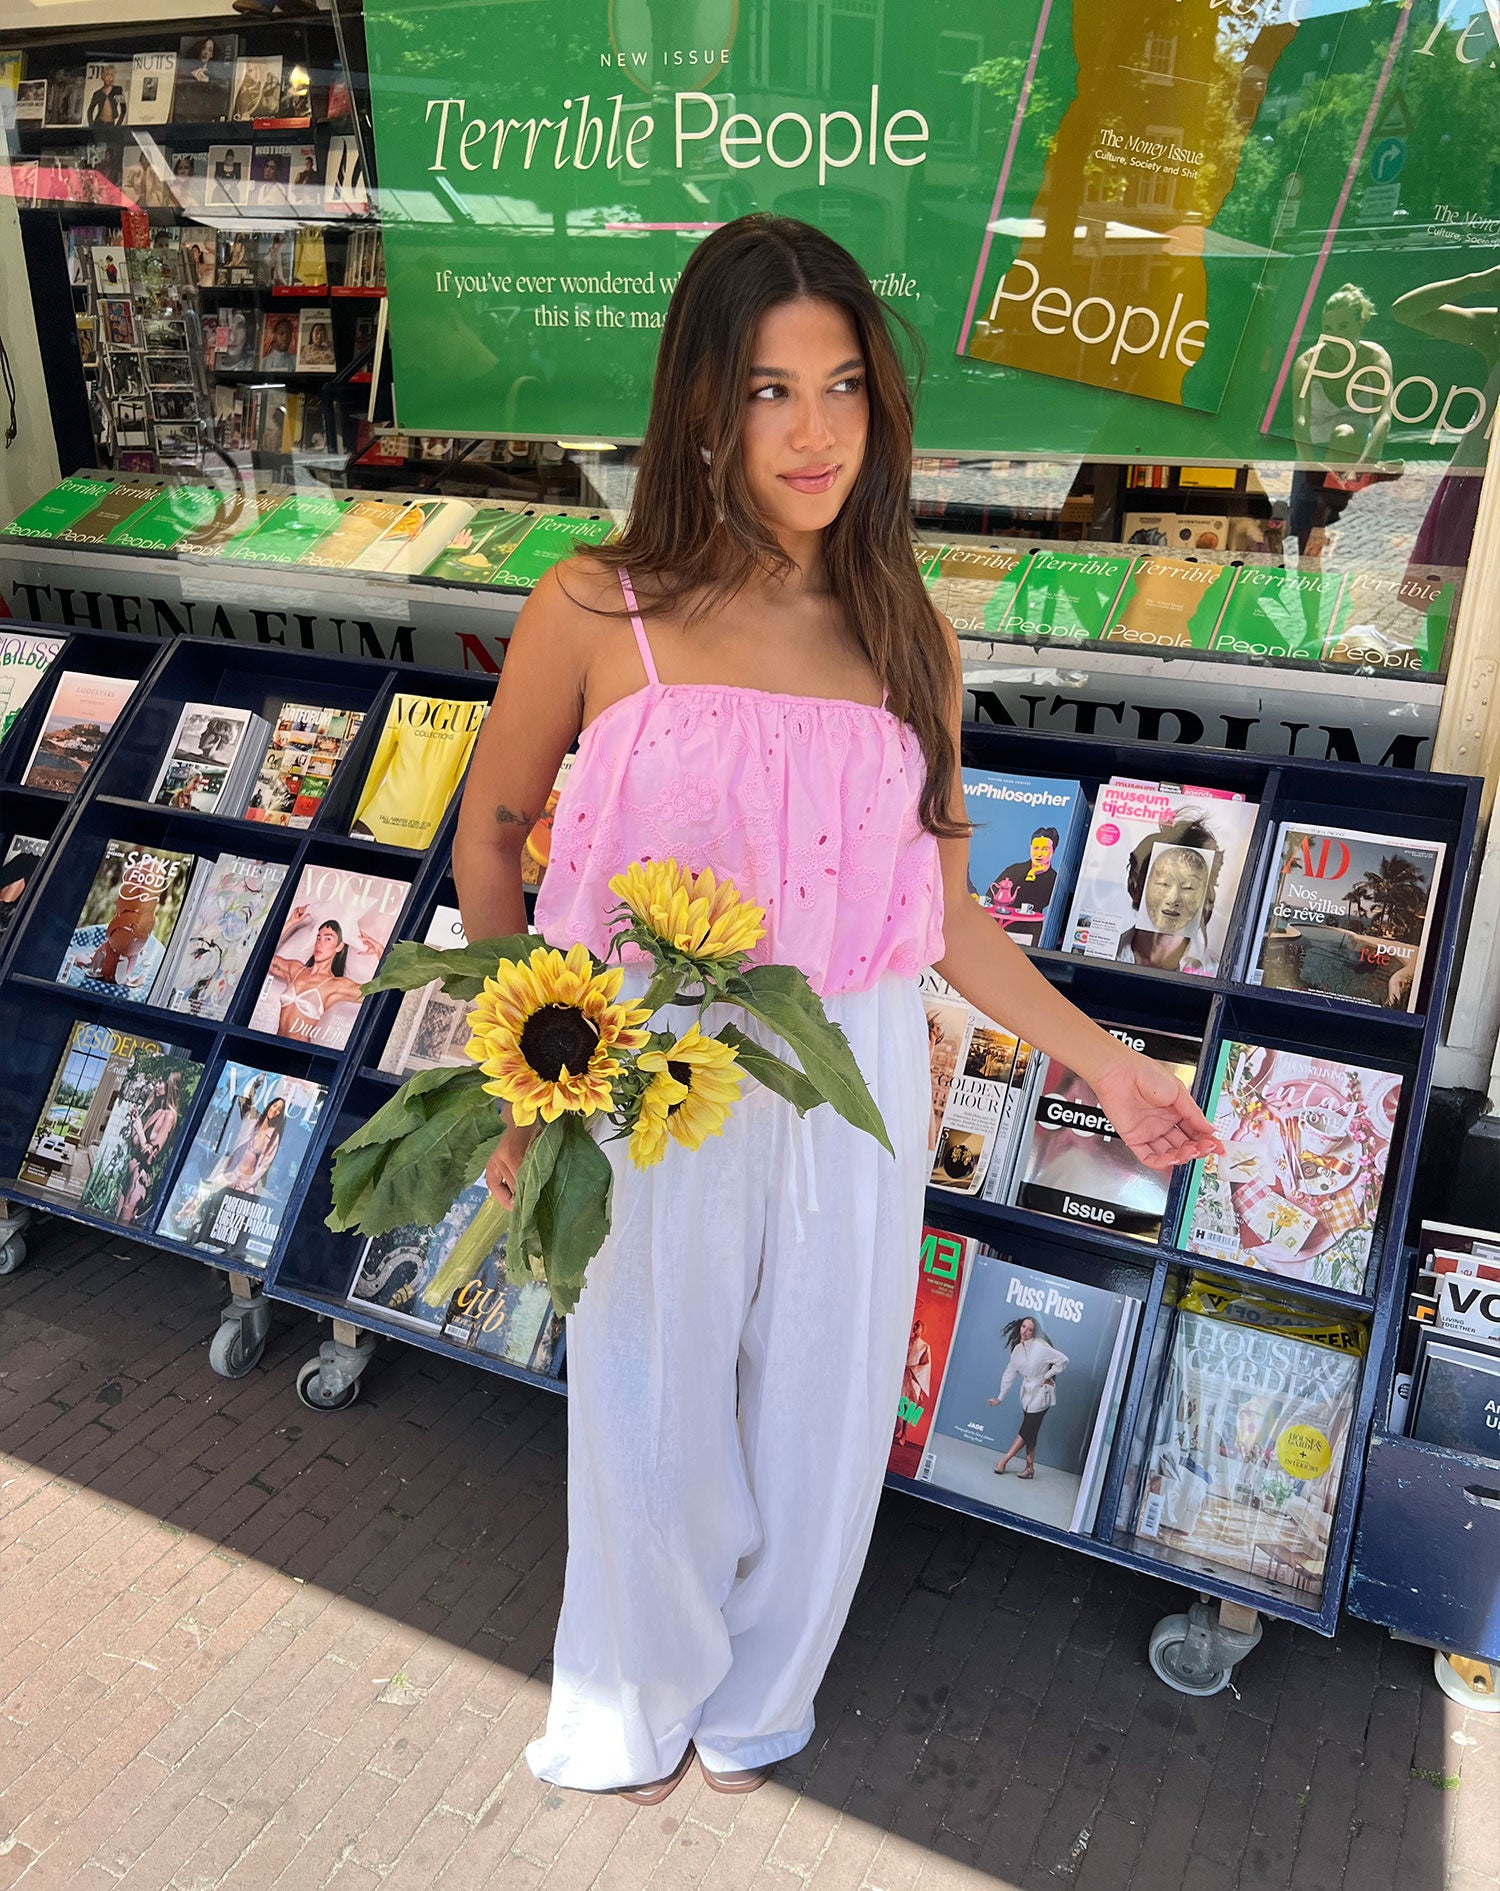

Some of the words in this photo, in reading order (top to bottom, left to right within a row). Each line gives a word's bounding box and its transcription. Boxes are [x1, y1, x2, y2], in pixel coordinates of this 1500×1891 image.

[600, 50, 649, 69] NEW
[663, 49, 731, 66] ISSUE
[424, 95, 655, 172] Terrible
[674, 84, 930, 187] People
[1100, 128, 1124, 149] The
[1124, 134, 1168, 161] Money
[1168, 143, 1204, 165] Issue
[1094, 149, 1127, 166] Culture,
[1129, 156, 1162, 173] Society
[1162, 165, 1180, 175] and
[1181, 167, 1198, 179] Shit
[1434, 204, 1460, 224] The
[1427, 224, 1462, 242] Culture,
[435, 269, 453, 293] If
[454, 270, 514, 299] you've
[515, 276, 557, 295] ever
[559, 271, 656, 295] wondered
[535, 304, 569, 328] this
[573, 305, 592, 328] is
[595, 305, 626, 328] the
[988, 258, 1210, 367] People
[1299, 334, 1496, 446] Peop
[56, 479, 107, 497] Terrible
[112, 483, 162, 501] Terrible
[169, 487, 219, 506] Terrible
[225, 493, 278, 513] Terrible
[284, 497, 340, 516] Terrible
[347, 503, 402, 520] Terribl
[3, 522, 52, 539] People
[56, 528, 106, 544] People
[535, 517, 602, 538] Terrible
[113, 533, 167, 550] People
[235, 547, 291, 562] People
[299, 551, 353, 568] Peopl
[941, 547, 1020, 572] Terrible
[1034, 554, 1118, 577] Terrible
[1135, 560, 1221, 585] Terrible
[1239, 569, 1331, 593] Terrible
[1349, 574, 1441, 602] Terrible
[0, 580, 417, 663] THENAEUM
[1005, 616, 1090, 638] People
[1107, 623, 1192, 648] People
[1217, 634, 1310, 658] People
[1330, 642, 1422, 670] People
[397, 697, 484, 733] VOGUE
[414, 729, 454, 741] COLLECTIONS
[967, 689, 1430, 771] NTRUM
[963, 783, 1071, 808] wPhilosopher
[1105, 788, 1169, 806] museum
[1115, 780, 1156, 792] museum
[1101, 800, 1176, 822] tijdschrift
[124, 850, 181, 877] SPIKE
[230, 861, 262, 877] THE
[1281, 835, 1351, 881] AD
[304, 868, 407, 916] VOGUE
[1288, 884, 1318, 900] Nos
[1273, 903, 1291, 918] de
[1293, 905, 1325, 924] rêve
[1310, 899, 1347, 916] villas
[1376, 943, 1415, 959] pour
[288, 1017, 321, 1039] Dua
[1108, 1029, 1146, 1052] The
[938, 1073, 1004, 1099] GOLDEN
[952, 1092, 999, 1114] HOUR
[1298, 1110, 1341, 1128] HOME
[1062, 1196, 1116, 1225] Issue
[1006, 1277, 1046, 1313] Puss
[1043, 1288, 1084, 1324] Puss
[1441, 1321, 1476, 1334] TOGETHER
[1442, 1316, 1465, 1326] LIVING
[1186, 1320, 1315, 1377] HOUSE
[1187, 1347, 1339, 1408] GARDEN
[967, 1421, 985, 1432] JADE
